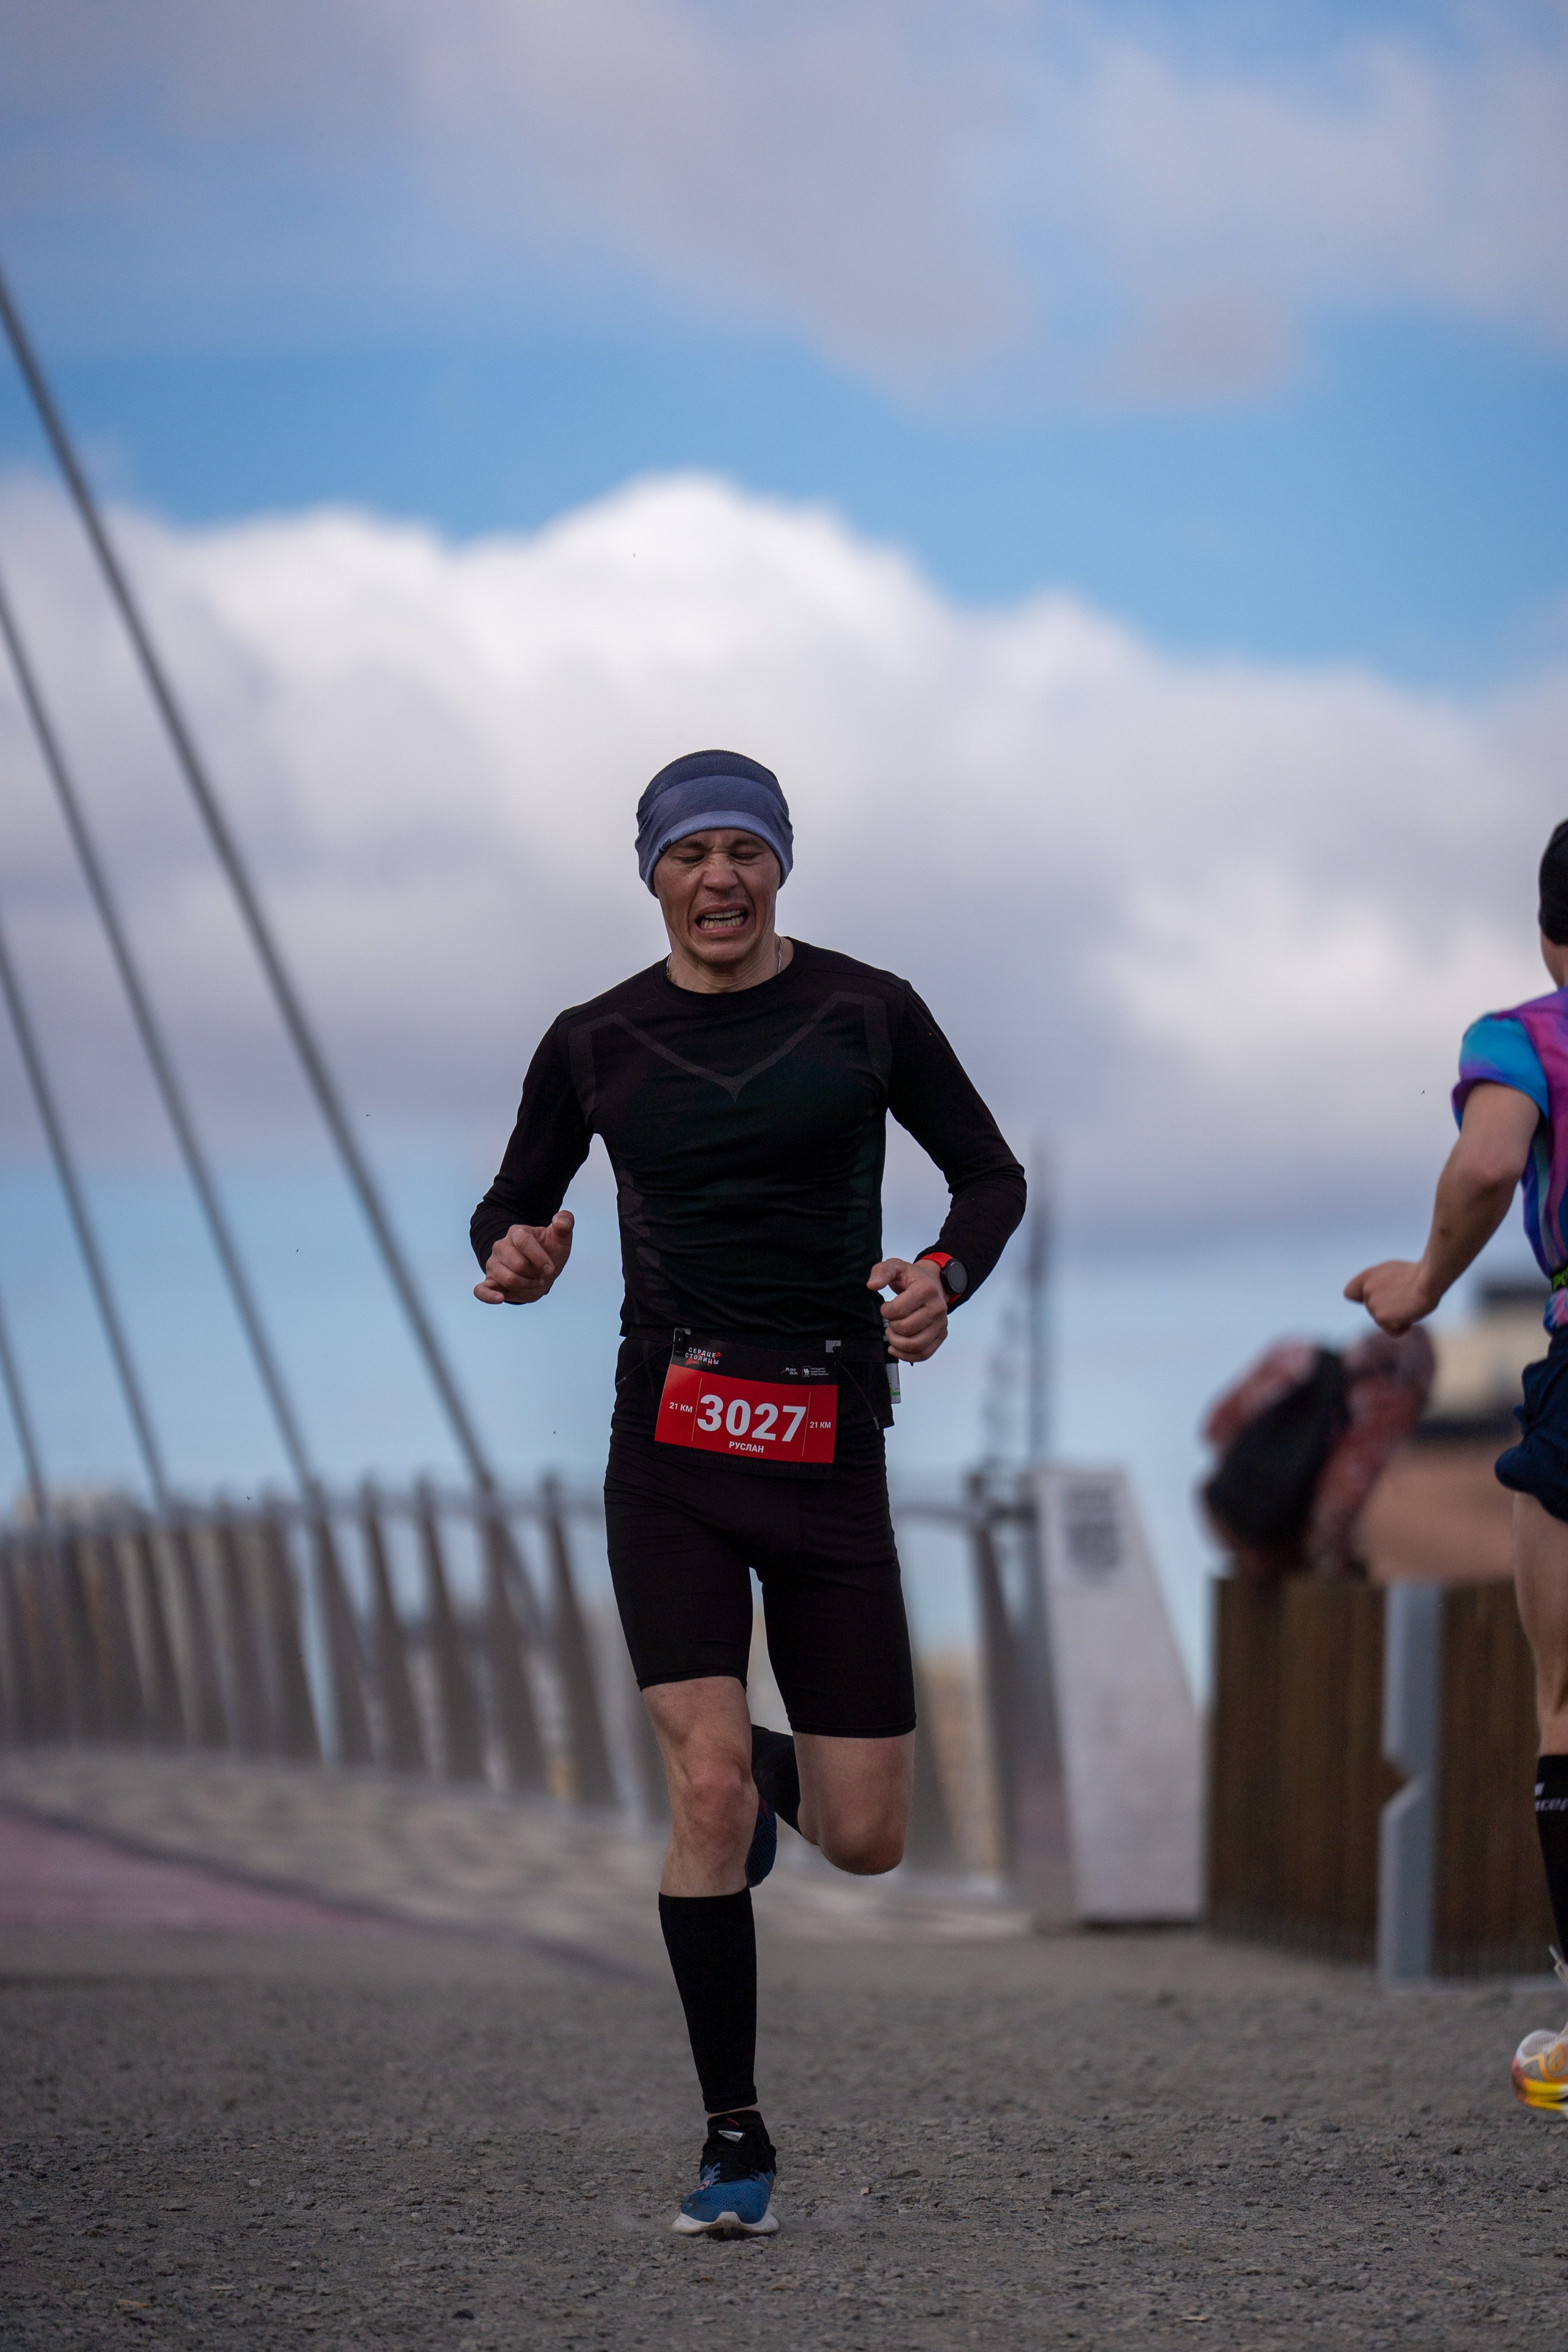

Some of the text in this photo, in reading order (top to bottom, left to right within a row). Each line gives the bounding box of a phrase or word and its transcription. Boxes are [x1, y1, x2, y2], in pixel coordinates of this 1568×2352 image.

[685, 1352, 719, 1365] СТОЛИЦЫ
[688, 1347, 716, 1358] СЕРДЦЕ
[697, 1394, 807, 1442] 3027
[729, 1441, 764, 1453] РУСЛАН
